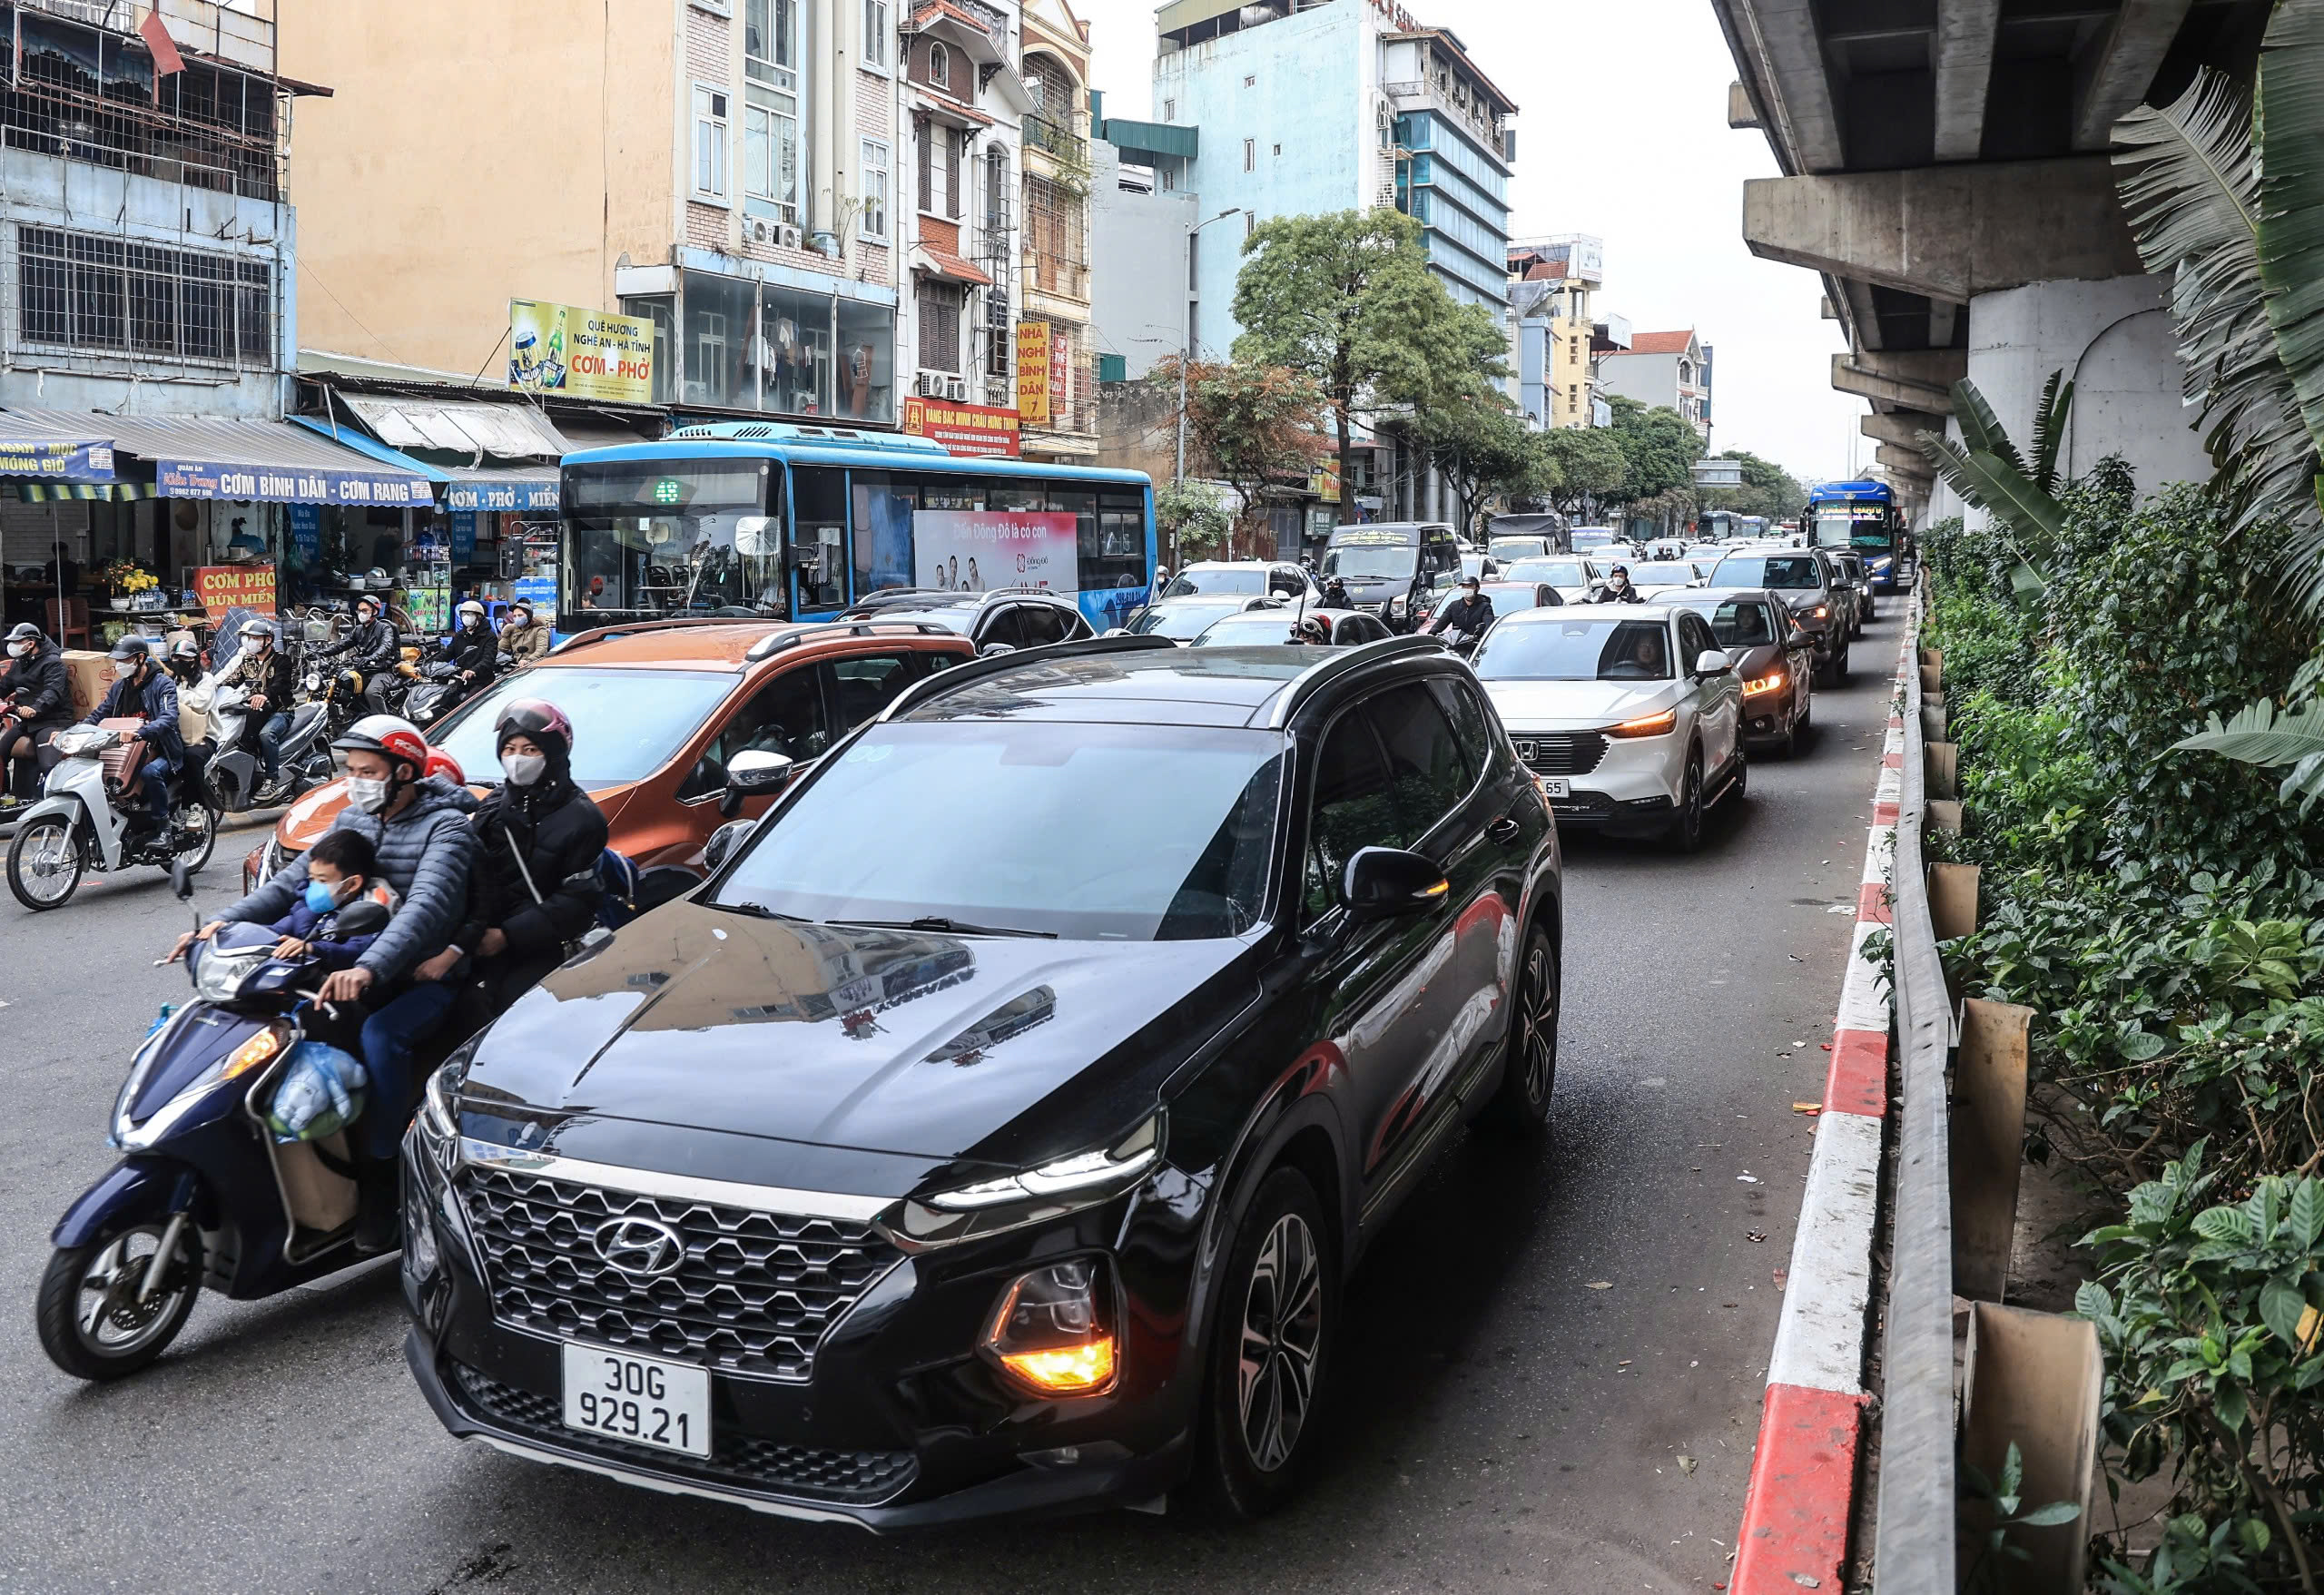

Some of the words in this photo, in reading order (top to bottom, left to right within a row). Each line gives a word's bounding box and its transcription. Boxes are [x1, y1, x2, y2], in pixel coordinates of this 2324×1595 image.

[588, 320, 605, 332] QUÊ
[607, 323, 638, 338] HƯƠNG
[1019, 325, 1044, 340] NHÀ
[574, 333, 597, 350] NGHỆ
[599, 337, 611, 349] AN
[617, 338, 628, 350] HÀ
[632, 340, 650, 354] TĨNH
[1019, 341, 1046, 358] NGHỈ
[572, 354, 606, 375] CƠM
[617, 358, 649, 379] PHỞ
[1019, 362, 1045, 377] BÌNH
[1020, 381, 1043, 396] DÂN
[926, 406, 941, 423] VÀNG
[943, 410, 954, 428] BẠC
[956, 411, 971, 427] MINH
[971, 411, 986, 428] CHÂU
[988, 414, 1002, 428] HƯNG
[0, 455, 38, 471] MÓNG
[221, 473, 255, 495] CƠM
[260, 473, 294, 497] BÌNH
[298, 475, 327, 498] DÂN
[340, 480, 370, 500] CƠM
[373, 483, 409, 502] RANG
[487, 487, 515, 507] PHỞ
[528, 485, 559, 507] MIẾN
[973, 523, 996, 541] Đông
[999, 523, 1009, 538] Đô
[1011, 524, 1019, 538] là
[1020, 522, 1029, 538] có
[1032, 526, 1047, 538] con
[203, 572, 240, 589] CƠM
[206, 593, 237, 606] BÚN
[241, 588, 275, 605] MIẾN
[1546, 782, 1561, 794] 65
[605, 1358, 665, 1400] 30G
[580, 1392, 687, 1448] 929.21
